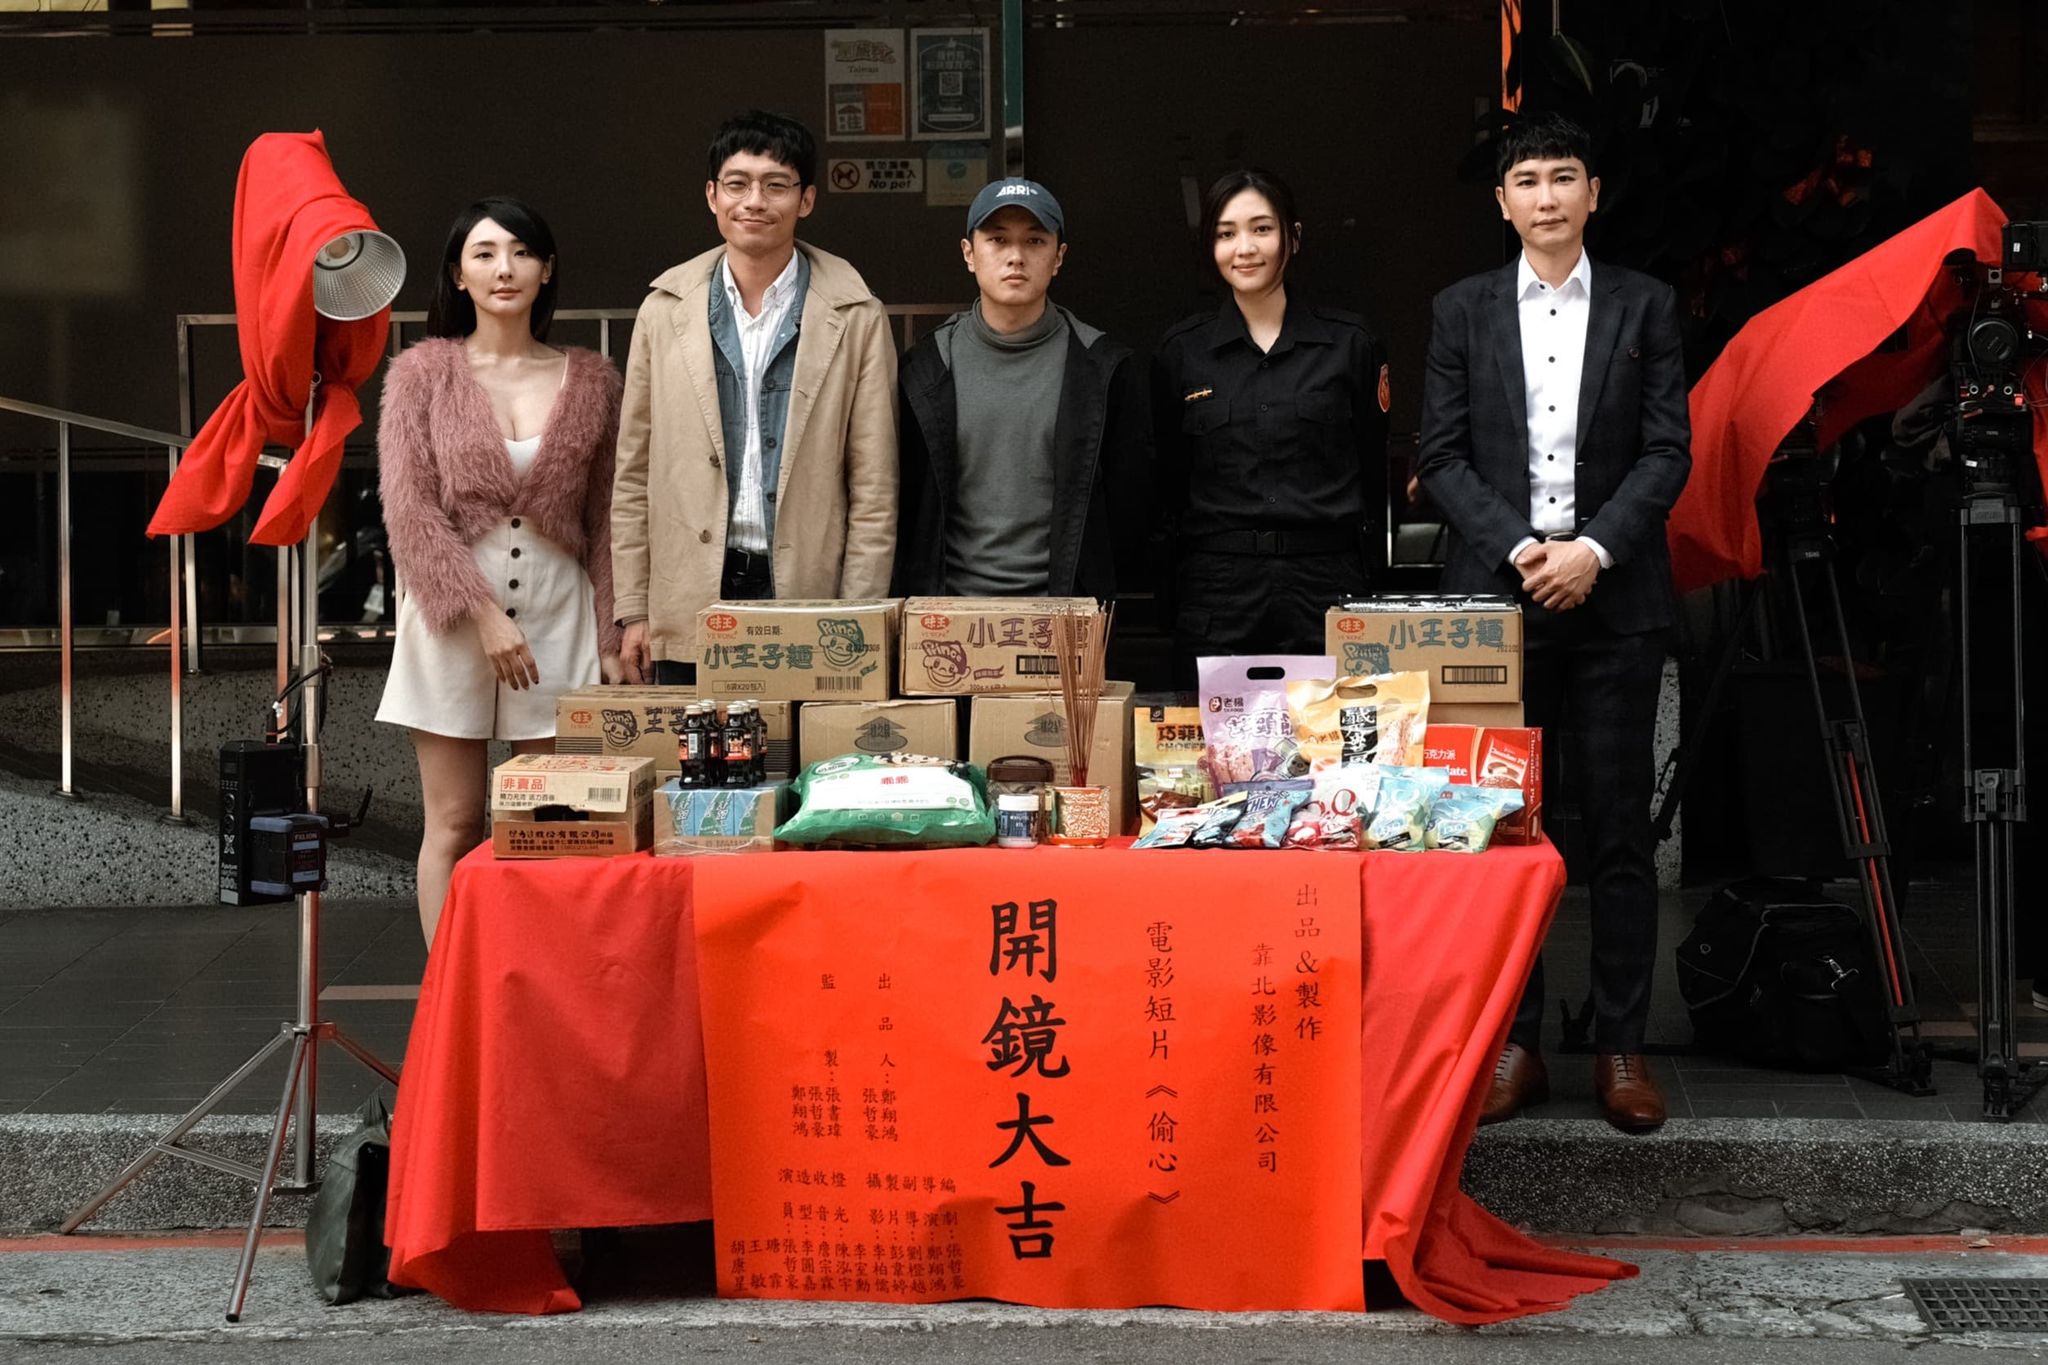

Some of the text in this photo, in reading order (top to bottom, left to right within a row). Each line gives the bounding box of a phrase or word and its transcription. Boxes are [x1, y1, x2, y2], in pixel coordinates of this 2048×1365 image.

[868, 179, 913, 190] No pet
[1388, 617, 1504, 650] 小王子麵
[704, 643, 814, 670] 小王子麵
[503, 778, 543, 790] 非賣品
[1293, 883, 1323, 1042] 出品&製作
[1250, 941, 1280, 1174] 靠北影像有限公司
[981, 898, 1072, 1261] 開鏡大吉
